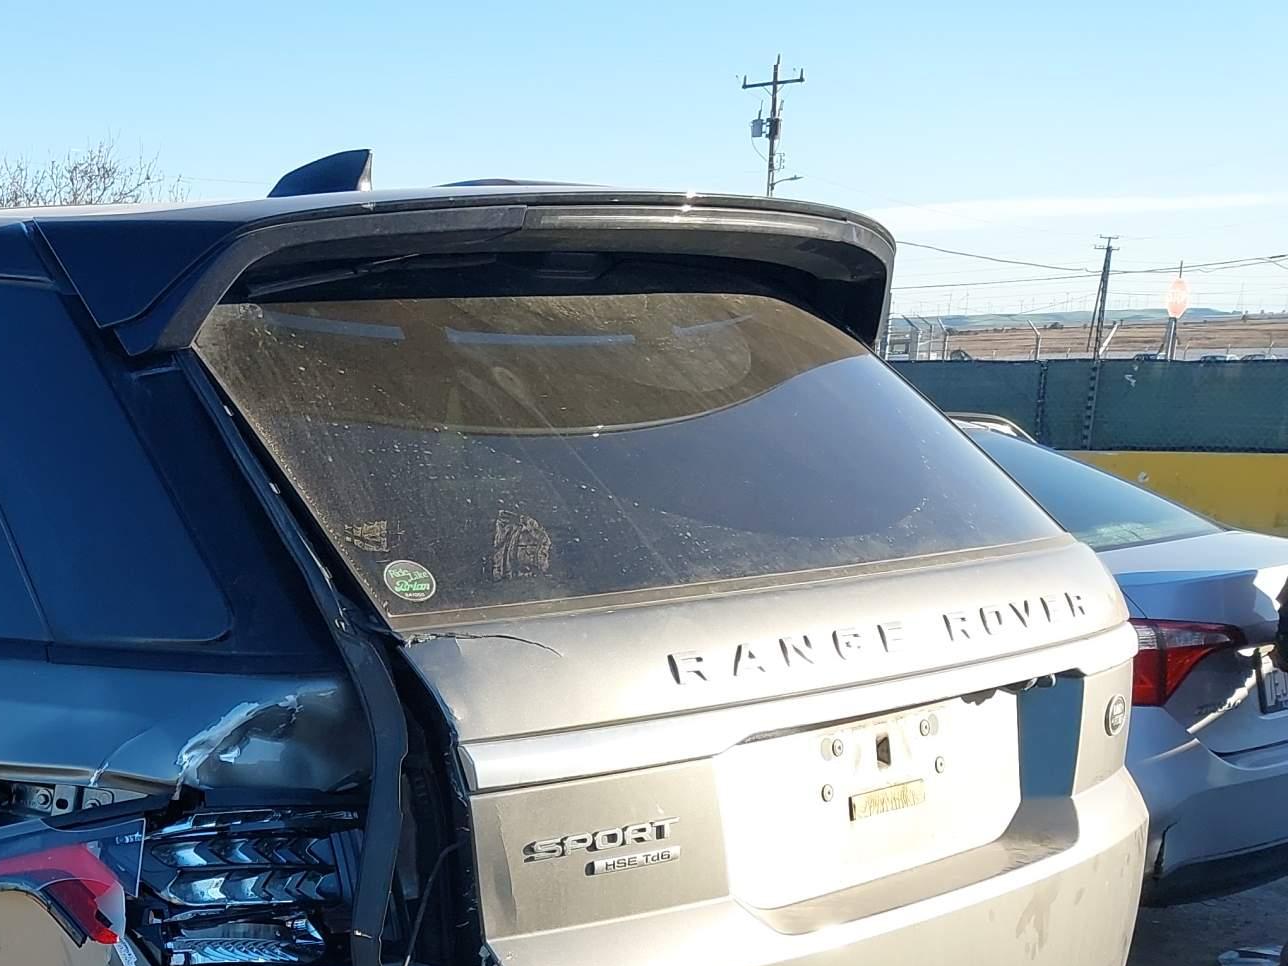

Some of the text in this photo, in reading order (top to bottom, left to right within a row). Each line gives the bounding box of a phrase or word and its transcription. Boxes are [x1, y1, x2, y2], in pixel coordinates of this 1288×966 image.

[667, 592, 1087, 685] RANGE ROVER
[522, 816, 680, 863] SPORT
[605, 850, 671, 872] HSE Td6
